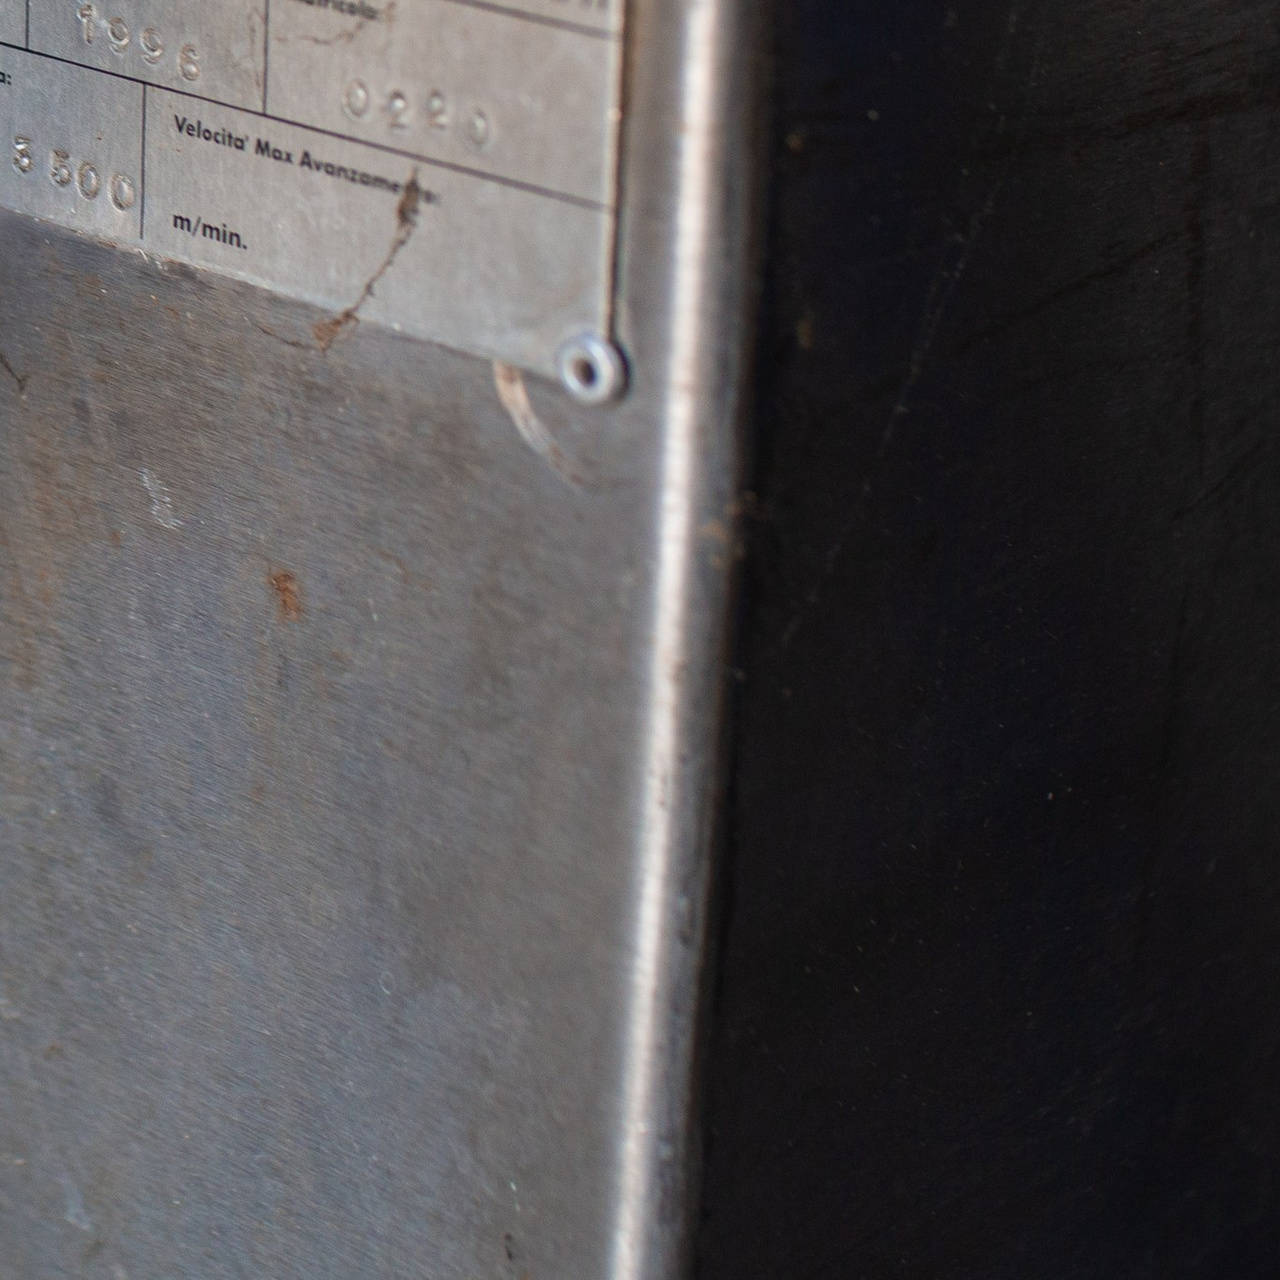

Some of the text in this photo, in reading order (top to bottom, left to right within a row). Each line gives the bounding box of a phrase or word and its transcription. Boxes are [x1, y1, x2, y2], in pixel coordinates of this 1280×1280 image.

[77, 2, 201, 82] 1996
[174, 114, 249, 151] Velocita'
[255, 138, 294, 165] Max
[173, 213, 248, 251] m/min.
